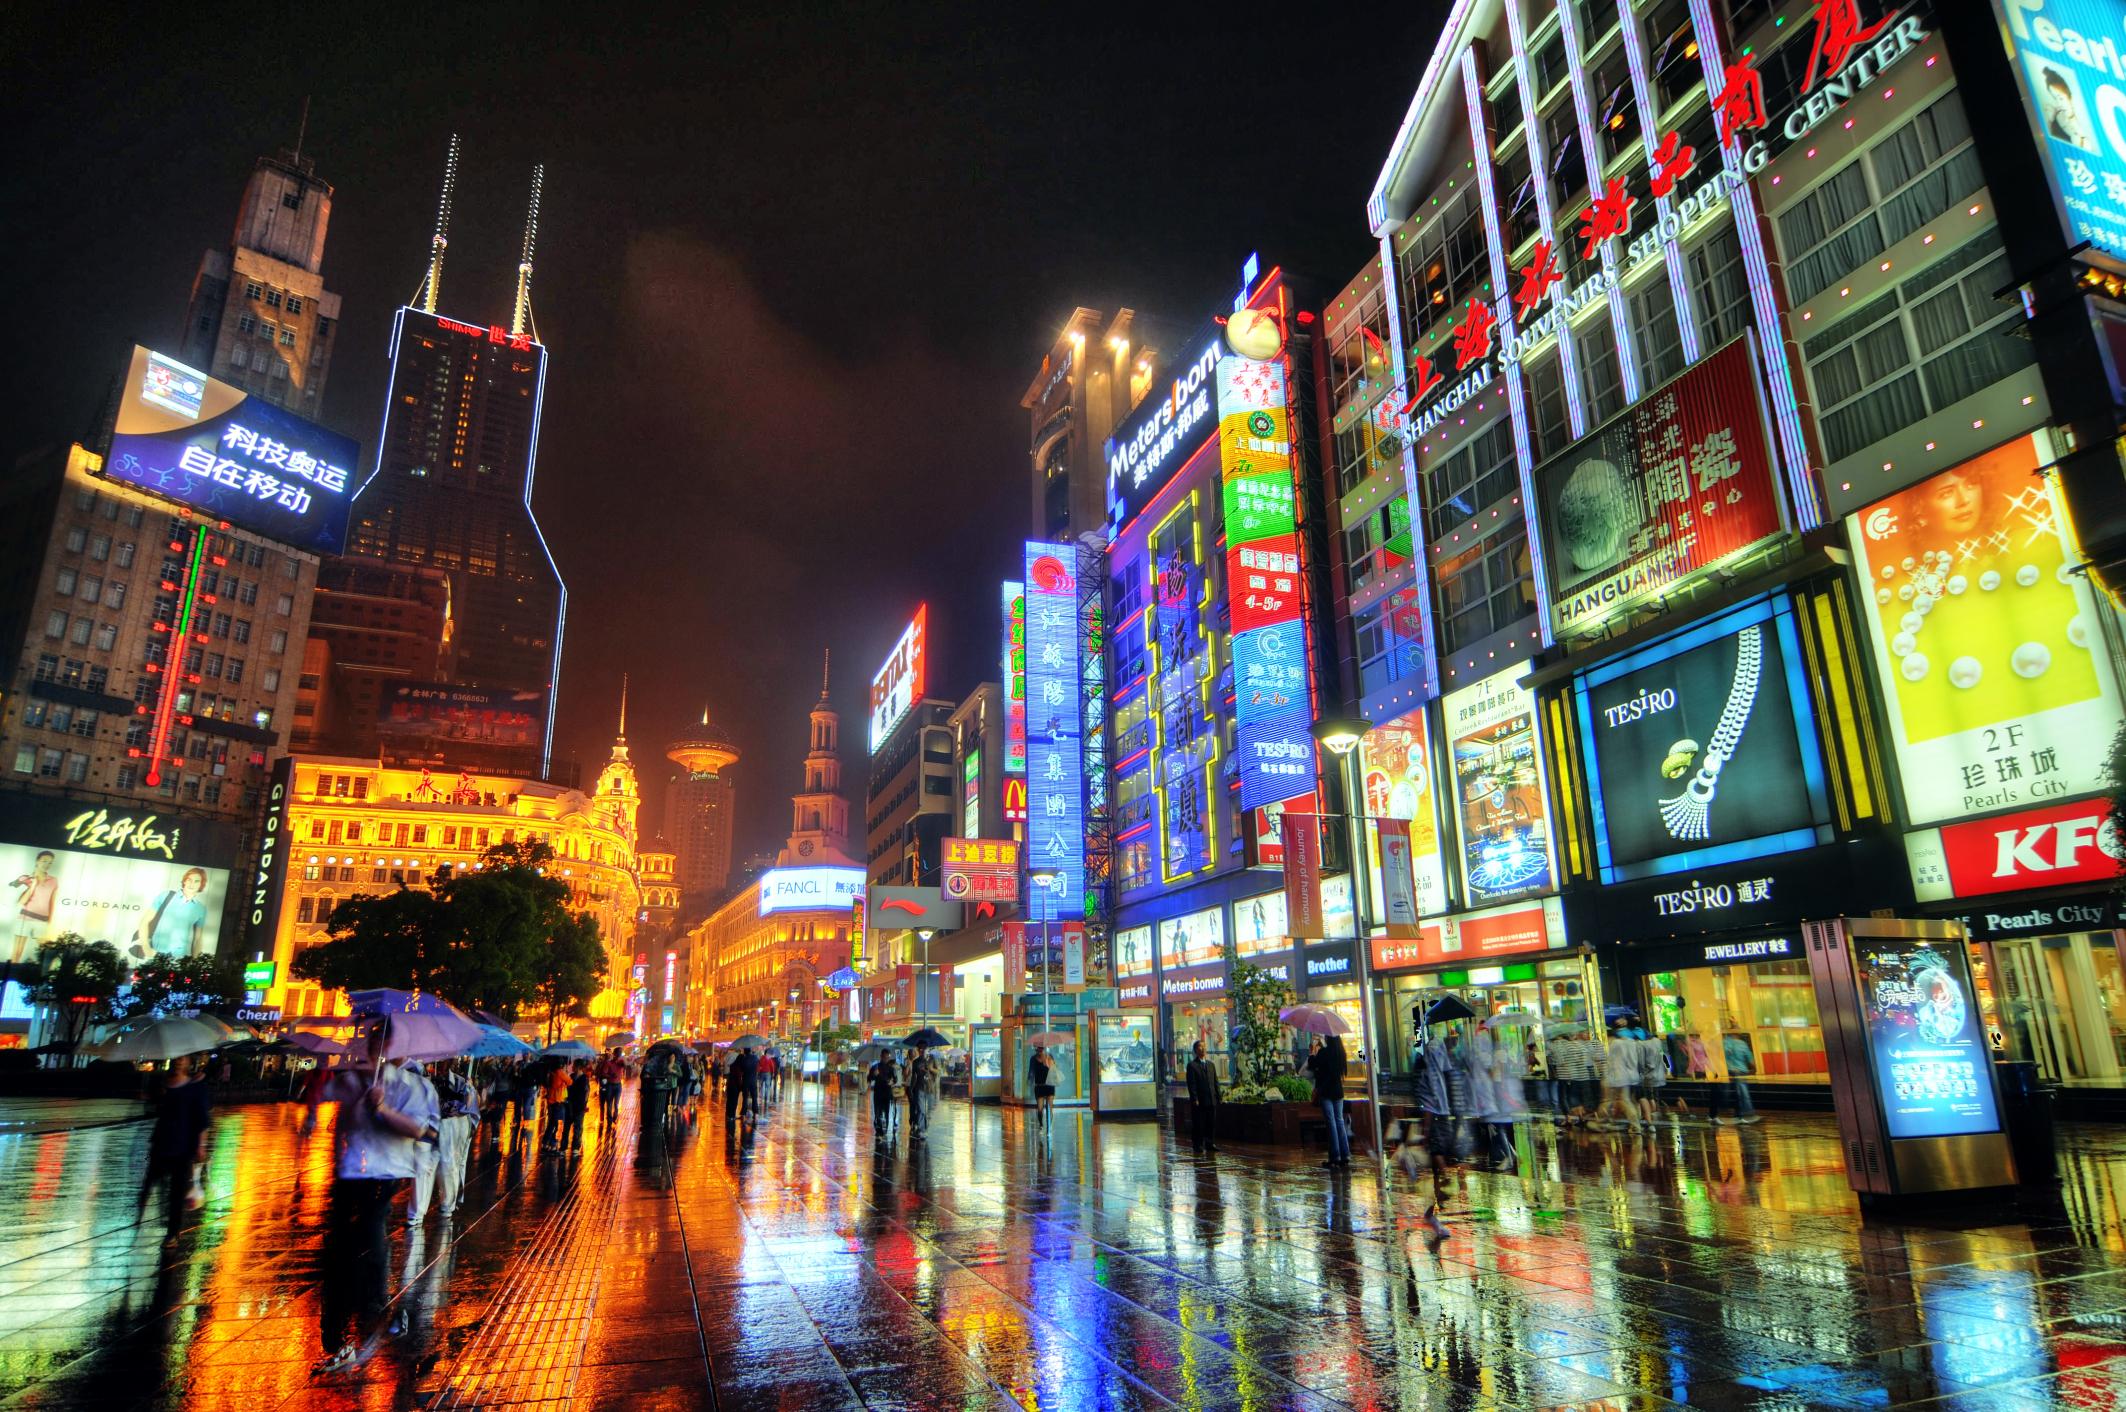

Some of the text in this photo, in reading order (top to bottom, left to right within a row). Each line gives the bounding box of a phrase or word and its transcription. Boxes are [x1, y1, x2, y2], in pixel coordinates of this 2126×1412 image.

[1403, 14, 1928, 446] SHANGHAI SOUVENIRS SHOPPING CENTER
[222, 422, 349, 493] 科技奥运
[178, 445, 312, 515] 自在移动
[415, 767, 478, 801] 永安
[1961, 746, 2060, 790] 珍珠城
[1963, 776, 2069, 811] Pearls City
[252, 783, 284, 926] GIORDANO
[1297, 828, 1306, 868] Journey
[61, 898, 141, 911] GIORDANO
[777, 880, 821, 895] FANCL
[1301, 880, 1312, 926] harmony
[1737, 878, 1772, 904] 通灵
[1985, 909, 2054, 932] Pearls
[2056, 905, 2104, 924] City
[1704, 940, 1768, 960] JEWELLERY
[1769, 937, 1788, 954] 珠宝
[1307, 956, 1350, 975] Brother
[1162, 977, 1194, 995] Meters
[1194, 975, 1224, 993] bonwe
